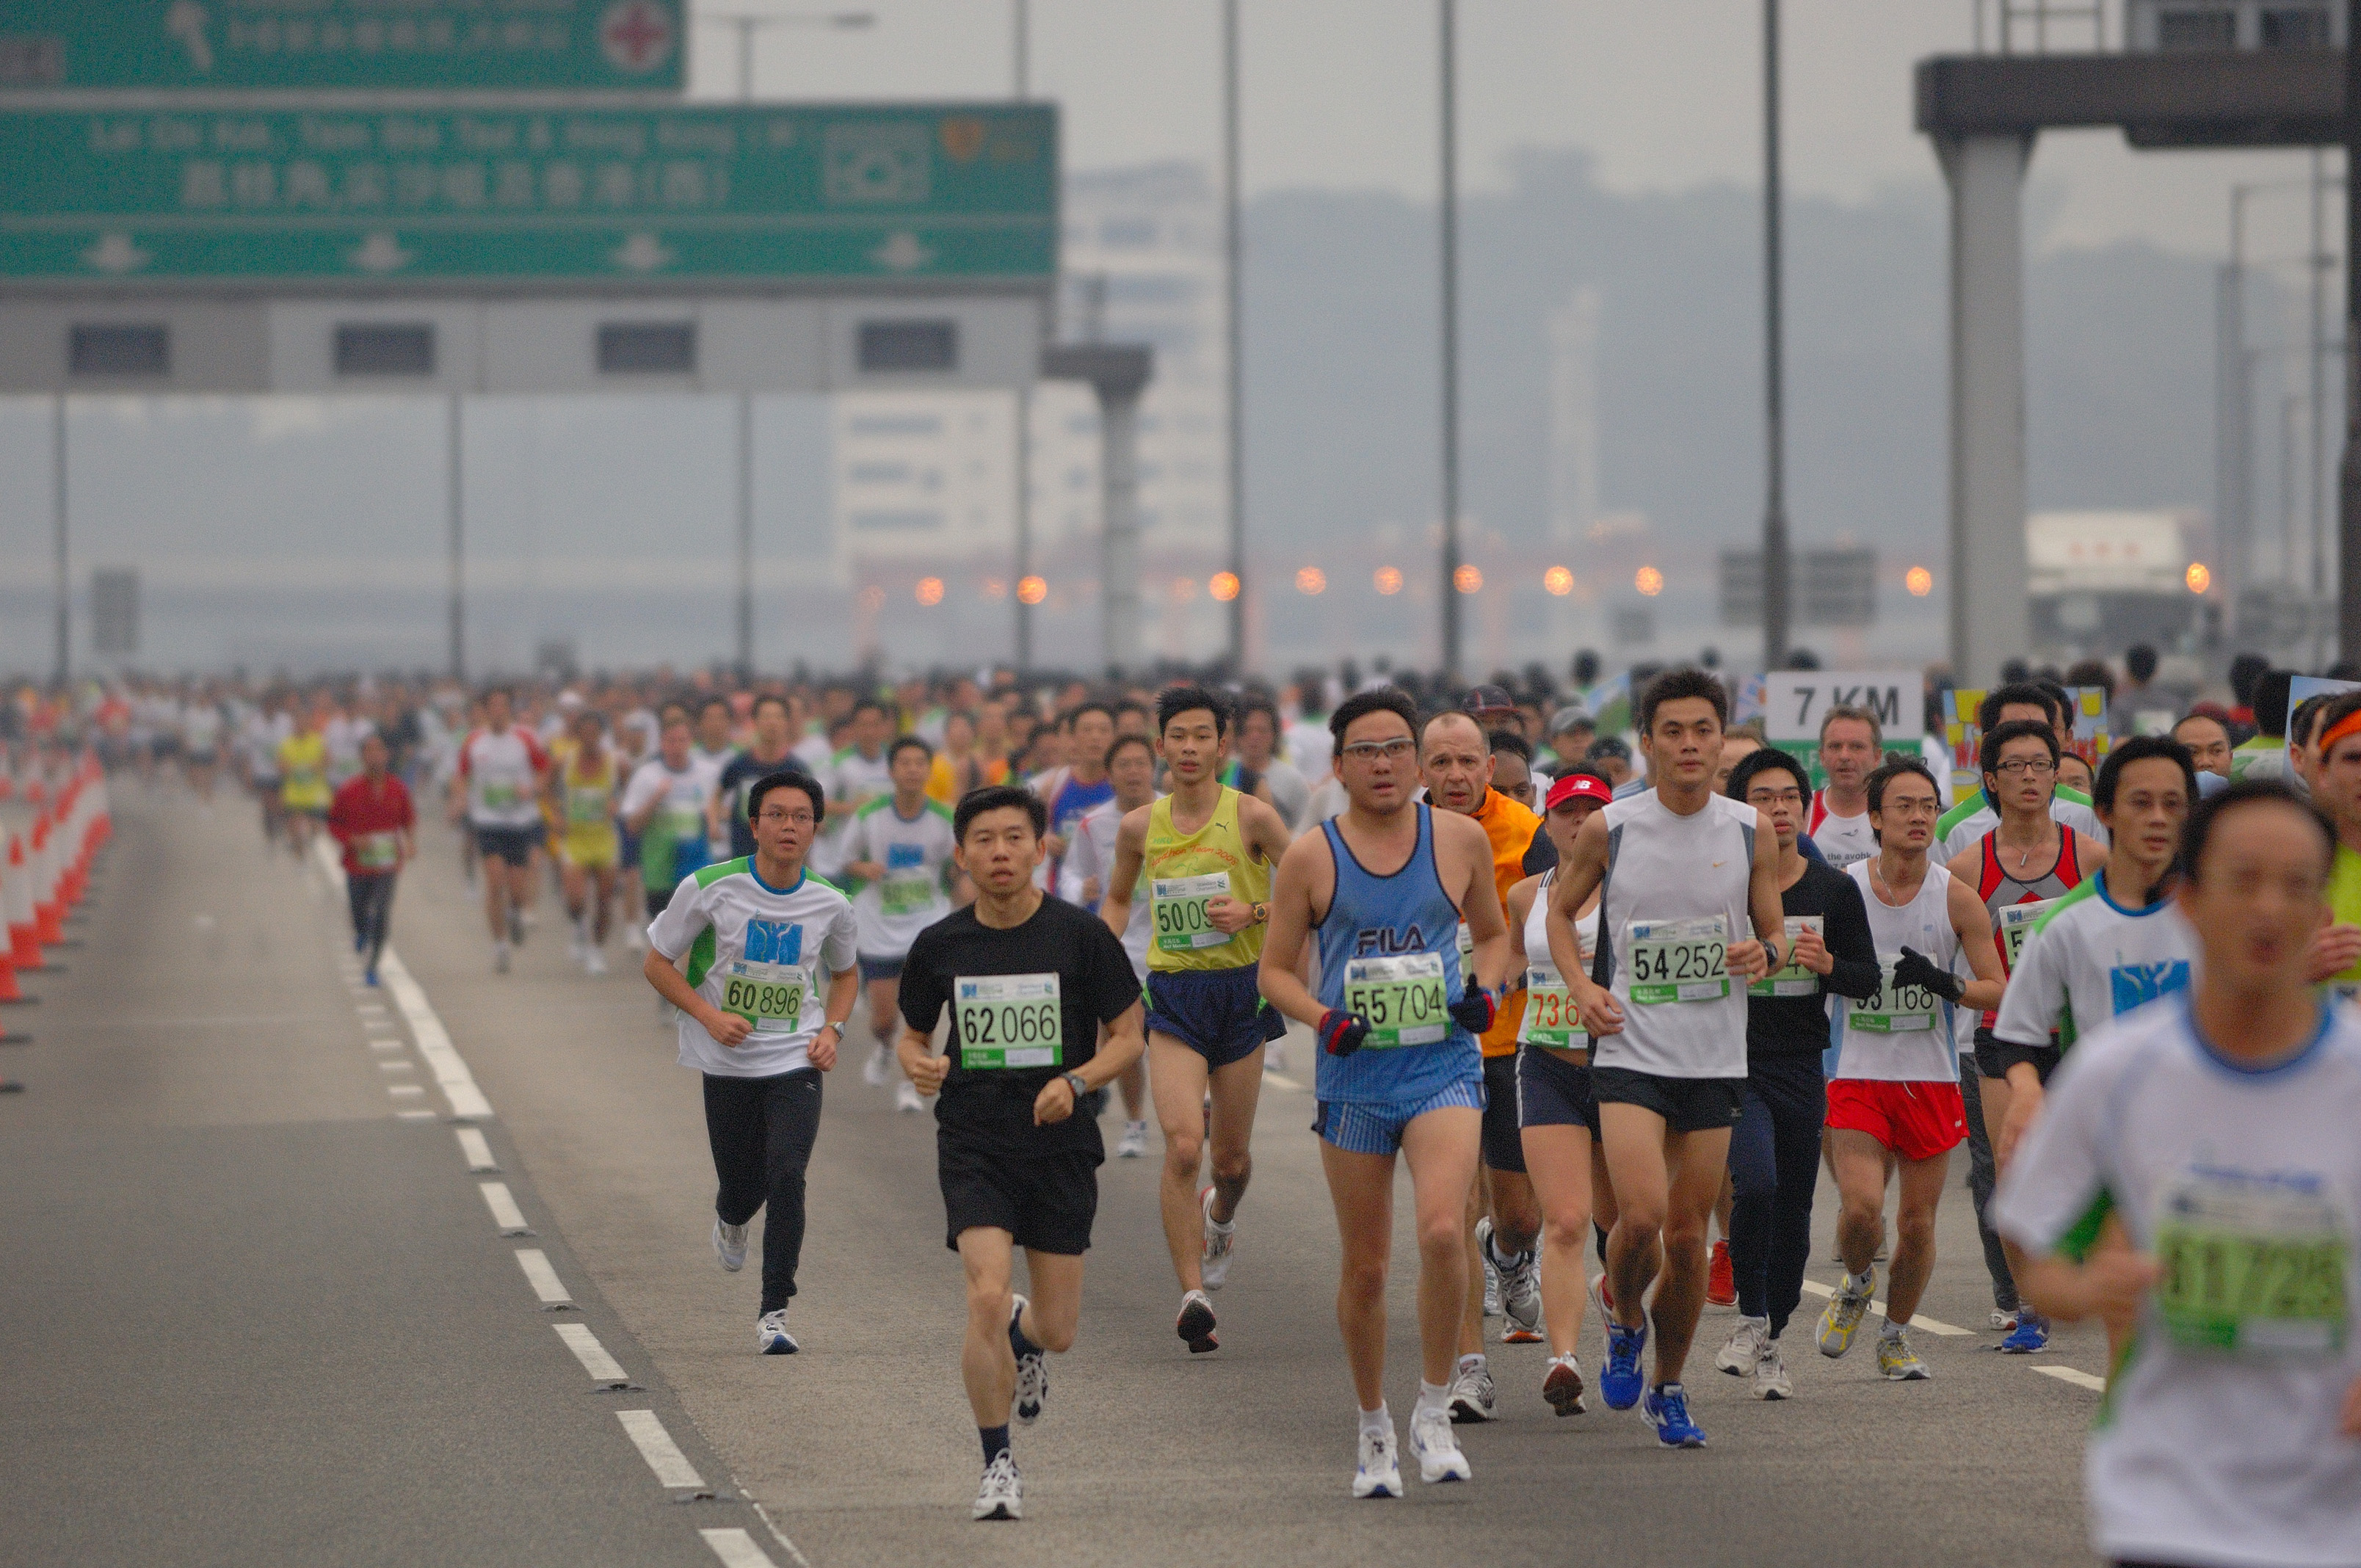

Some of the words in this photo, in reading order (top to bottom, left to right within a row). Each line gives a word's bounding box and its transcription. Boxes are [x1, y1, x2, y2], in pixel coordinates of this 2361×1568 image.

[1794, 686, 1816, 725] 7
[1151, 847, 1187, 868] Marathon
[1190, 843, 1215, 854] Team
[1216, 848, 1239, 866] 2008
[1158, 899, 1214, 932] 5009
[1358, 924, 1426, 955] FILA
[1635, 943, 1724, 980] 54252
[728, 980, 800, 1015] 60896
[1353, 984, 1442, 1023] 55704
[1533, 992, 1580, 1027] 736
[965, 1004, 1055, 1043] 62066
